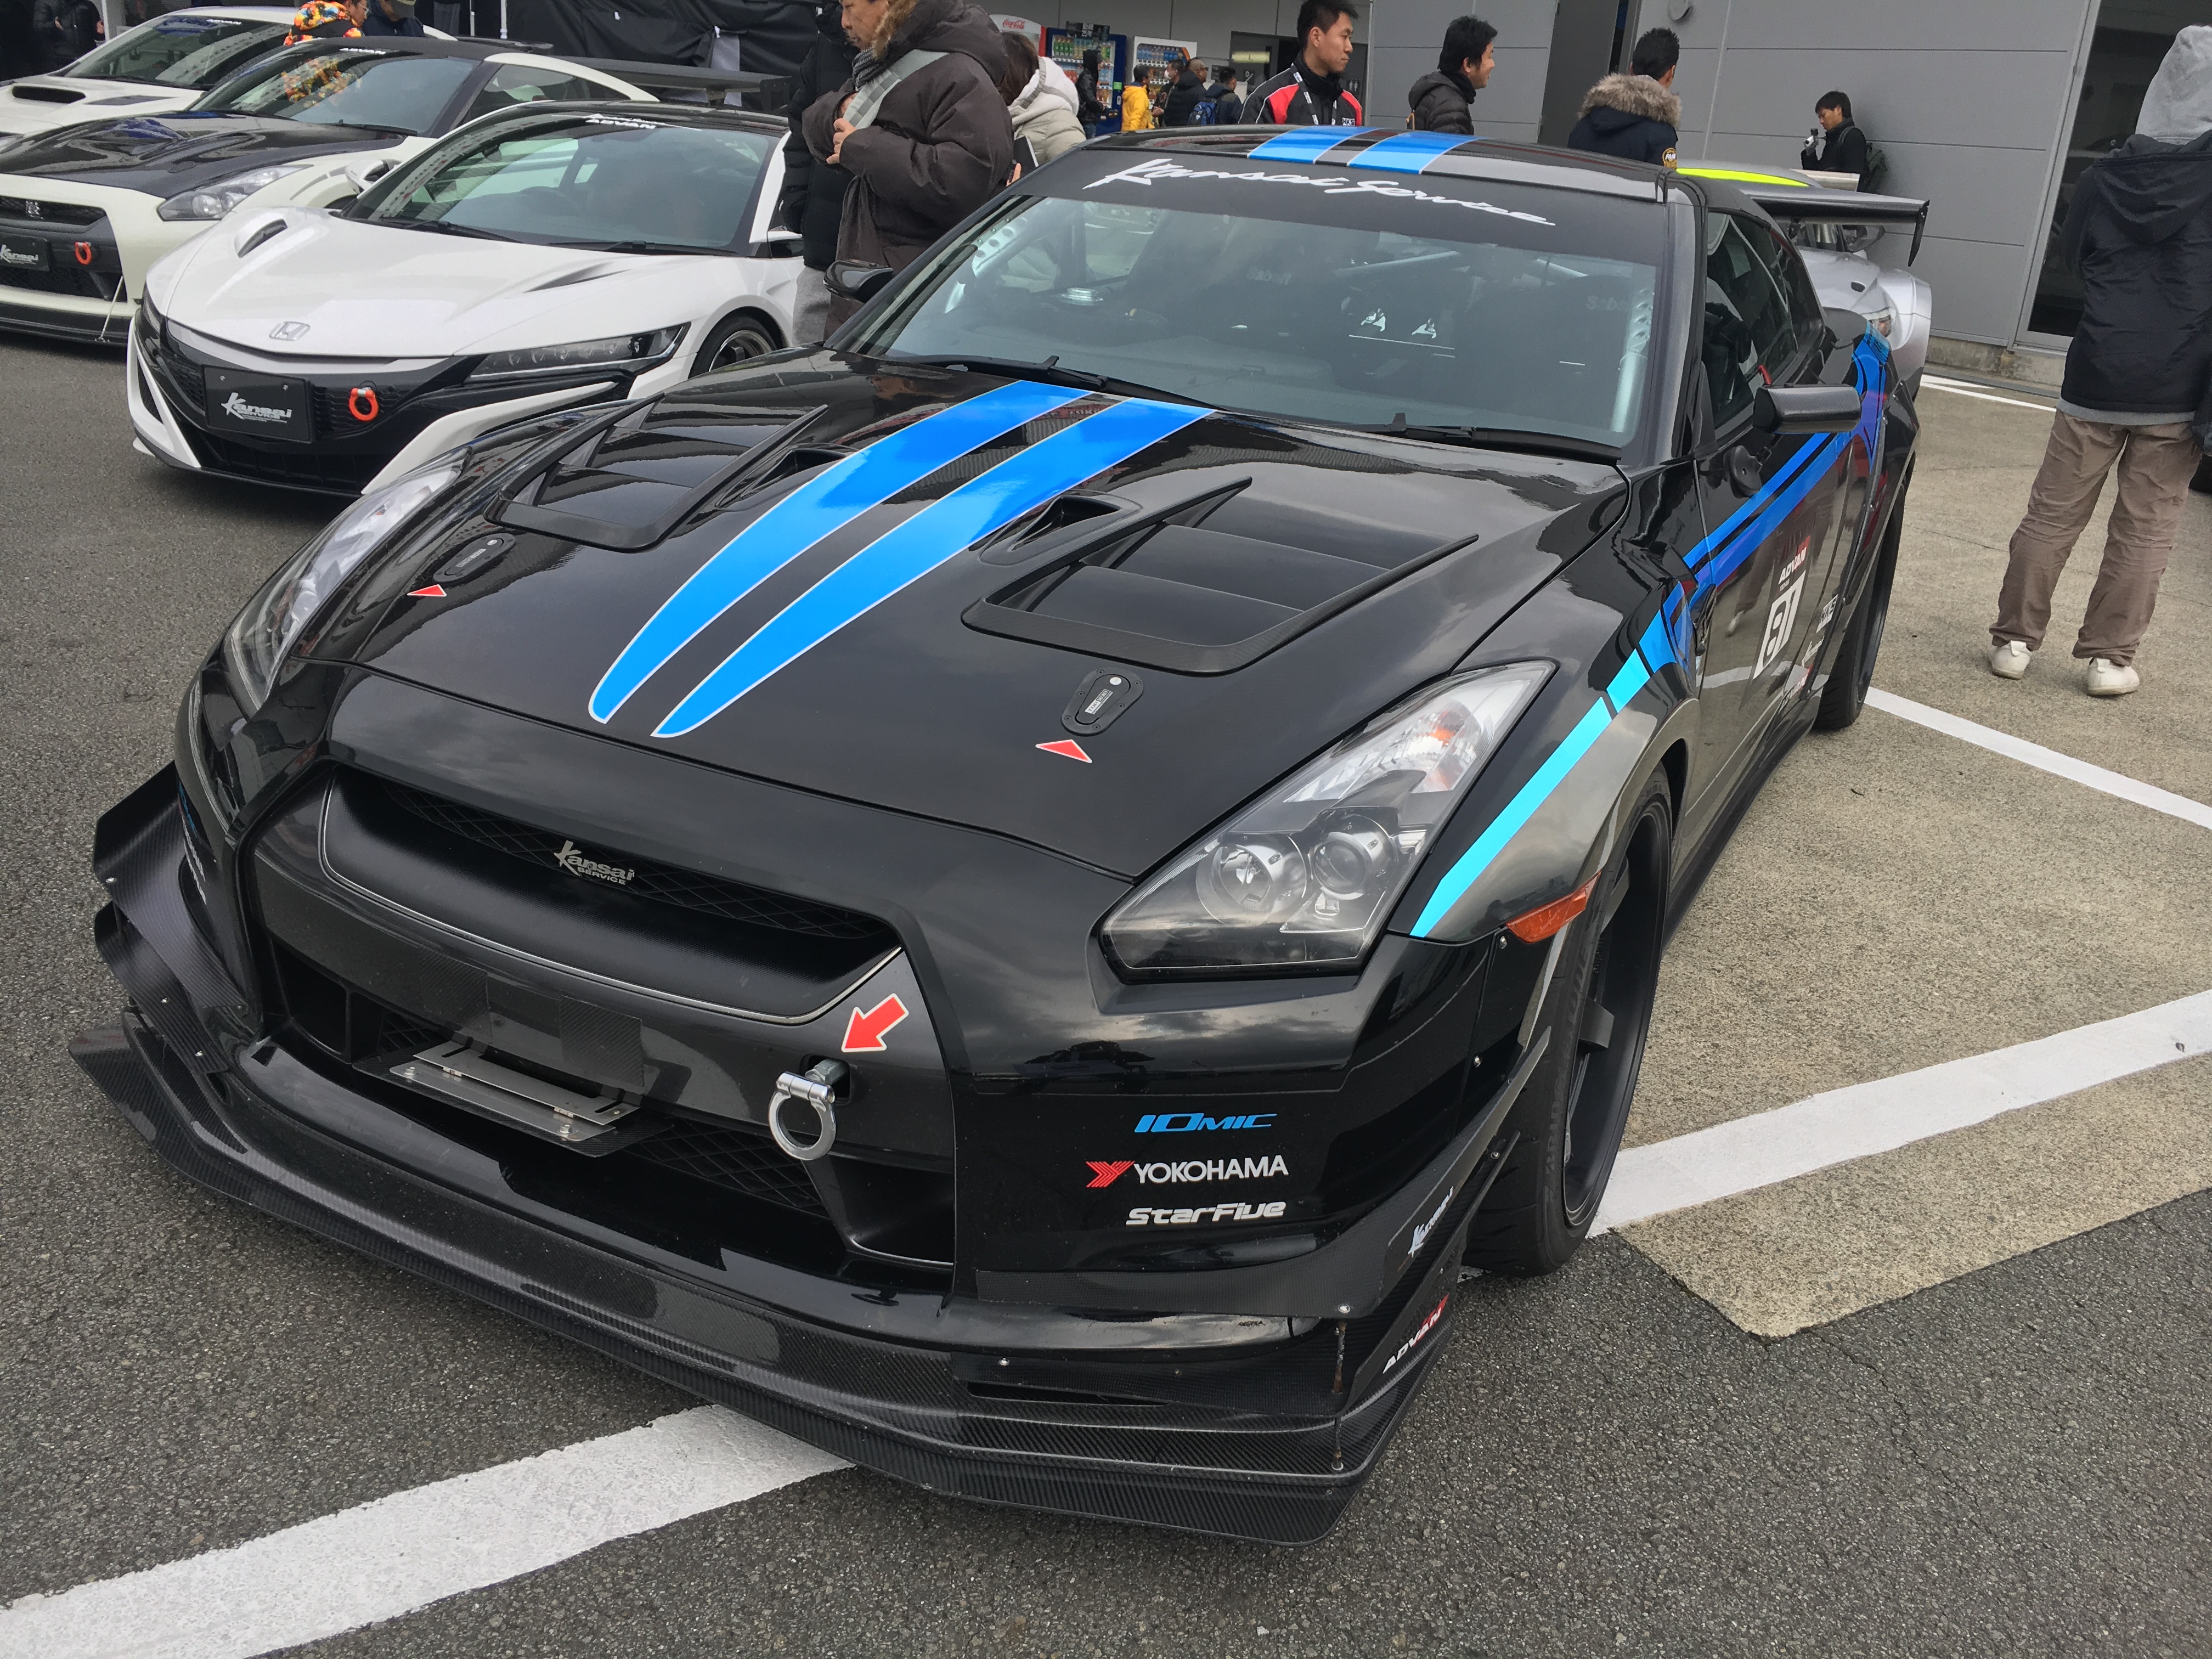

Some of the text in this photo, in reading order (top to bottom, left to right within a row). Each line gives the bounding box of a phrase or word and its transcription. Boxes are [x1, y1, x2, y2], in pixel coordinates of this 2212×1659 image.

[585, 119, 656, 129] ADVAN
[1342, 117, 1355, 126] HKS
[1082, 158, 1556, 226] Kansai Service
[221, 392, 292, 420] Kansai
[1778, 546, 1808, 585] ADVAN
[554, 840, 635, 881] Kansai
[577, 867, 626, 885] SERVICE
[1133, 1155, 1289, 1183] YOKOHAMA
[1125, 1201, 1286, 1226] StarFive
[1383, 1307, 1442, 1374] ADVAN
